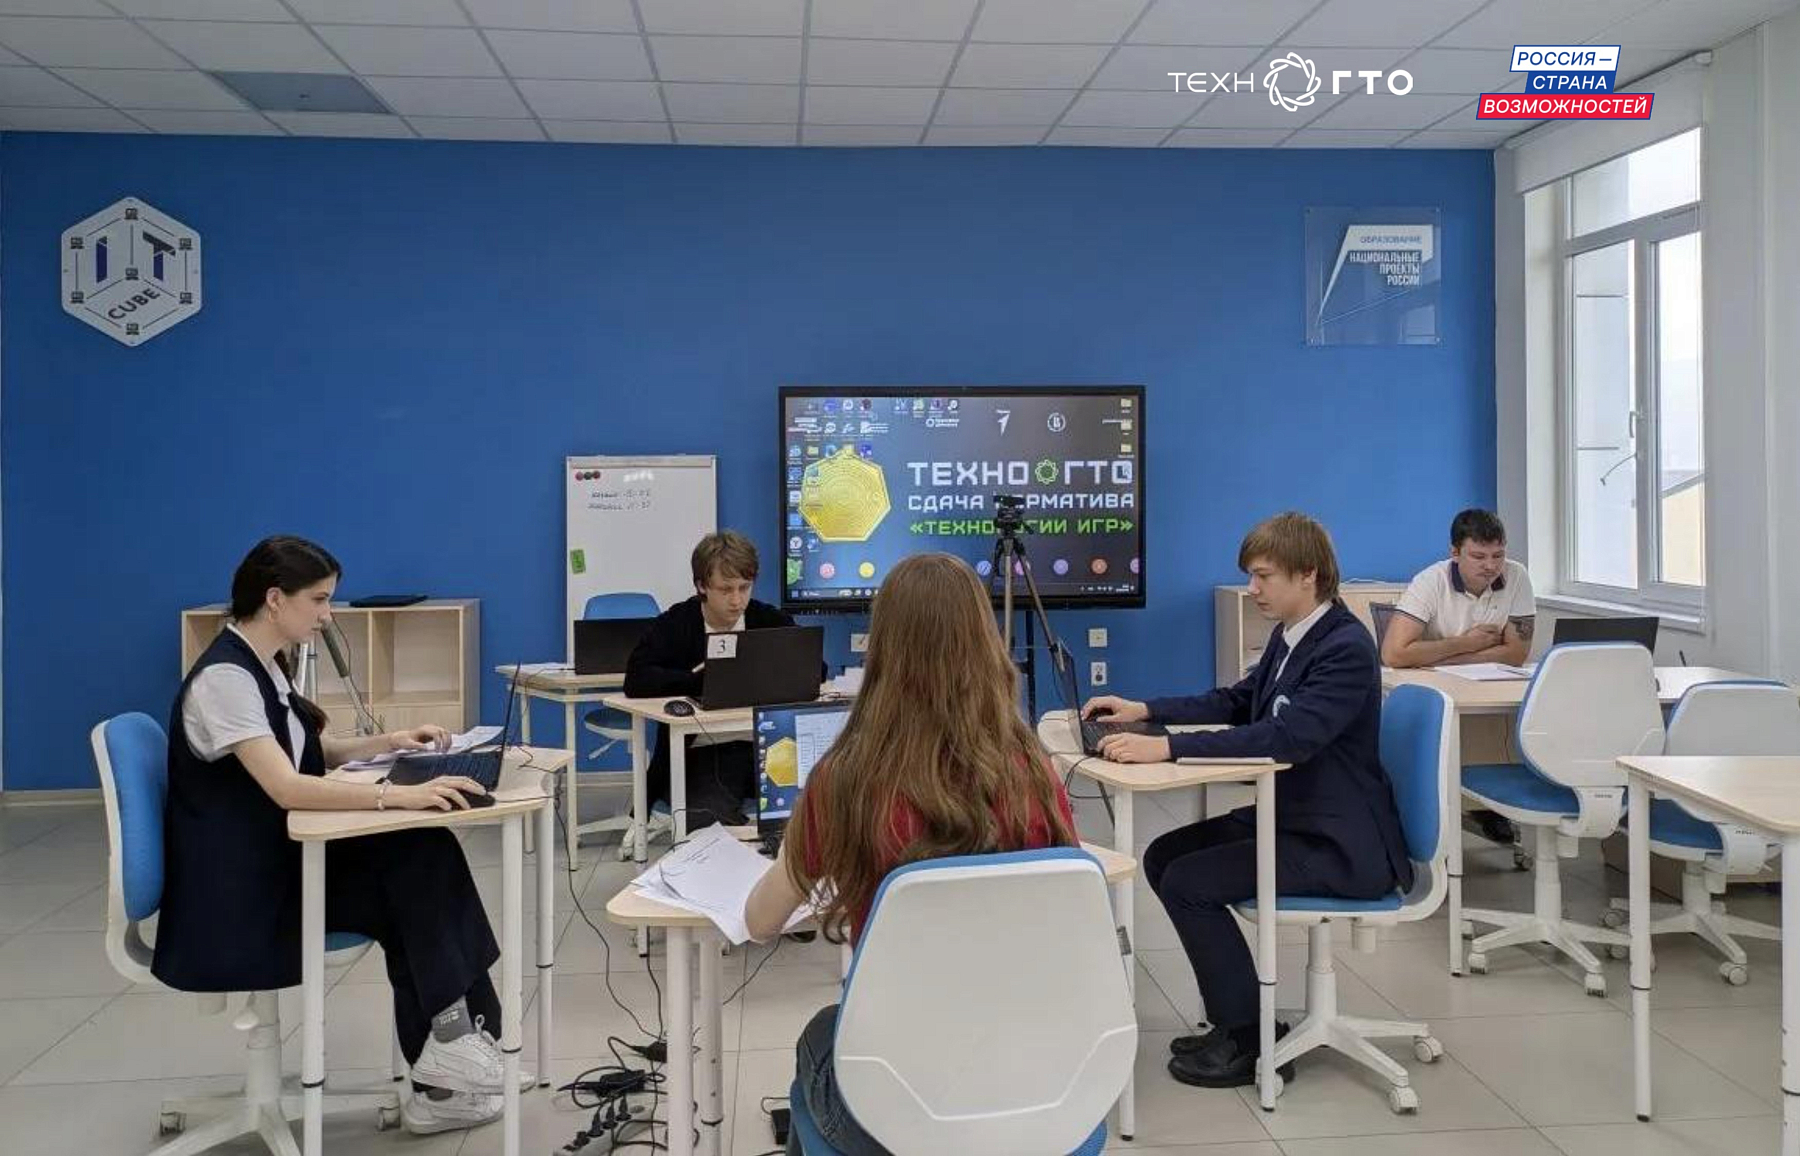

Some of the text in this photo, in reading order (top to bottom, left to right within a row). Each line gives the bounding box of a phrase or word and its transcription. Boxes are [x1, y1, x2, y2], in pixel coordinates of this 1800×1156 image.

[1350, 251, 1420, 263] НАЦИОНАЛЬНЫЕ
[1379, 263, 1420, 275] ПРОЕКТЫ
[1387, 275, 1420, 286] РОССИИ
[108, 288, 160, 319] CUBE
[907, 461, 1133, 486] ТЕХНО ГТО
[908, 495, 984, 513] СДАЧА
[717, 639, 726, 654] 3
